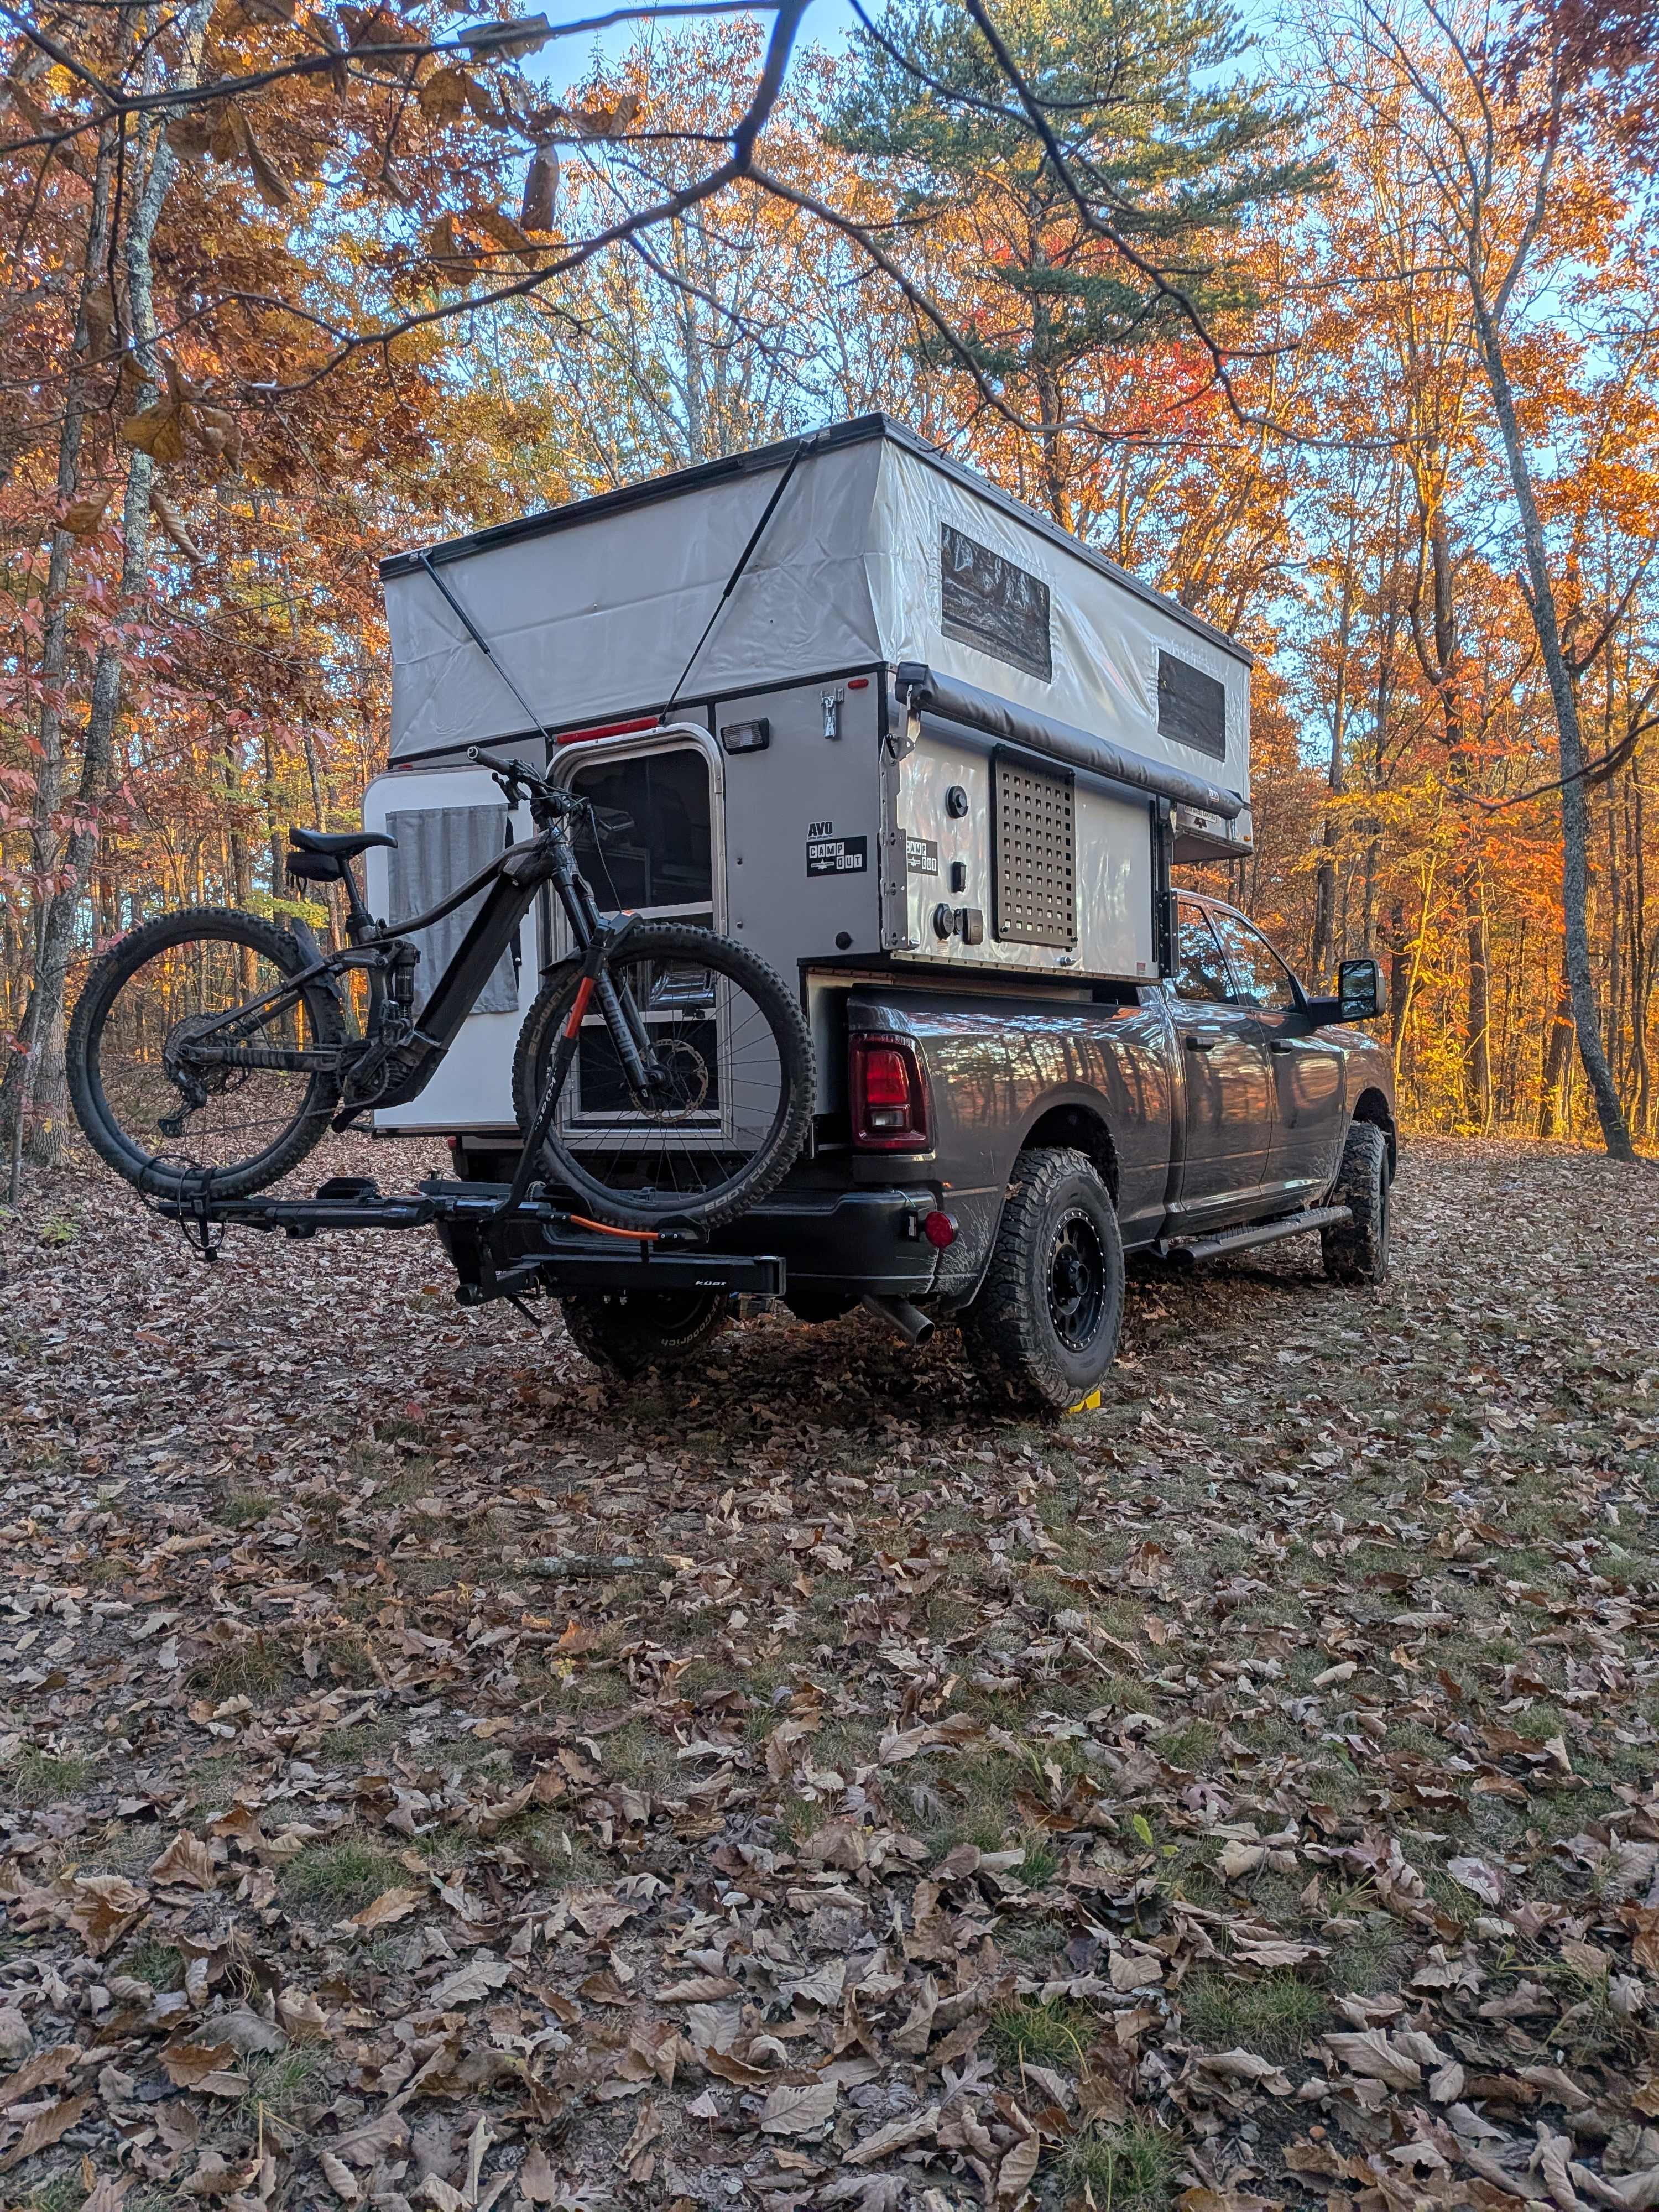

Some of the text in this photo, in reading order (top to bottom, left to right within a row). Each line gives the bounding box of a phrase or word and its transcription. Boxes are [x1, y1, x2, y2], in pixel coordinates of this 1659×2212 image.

[808, 821, 833, 837] AVO
[810, 843, 843, 858] CAMP
[837, 855, 860, 869] OUT
[922, 858, 936, 870] OUT
[704, 1181, 747, 1212] EDDY
